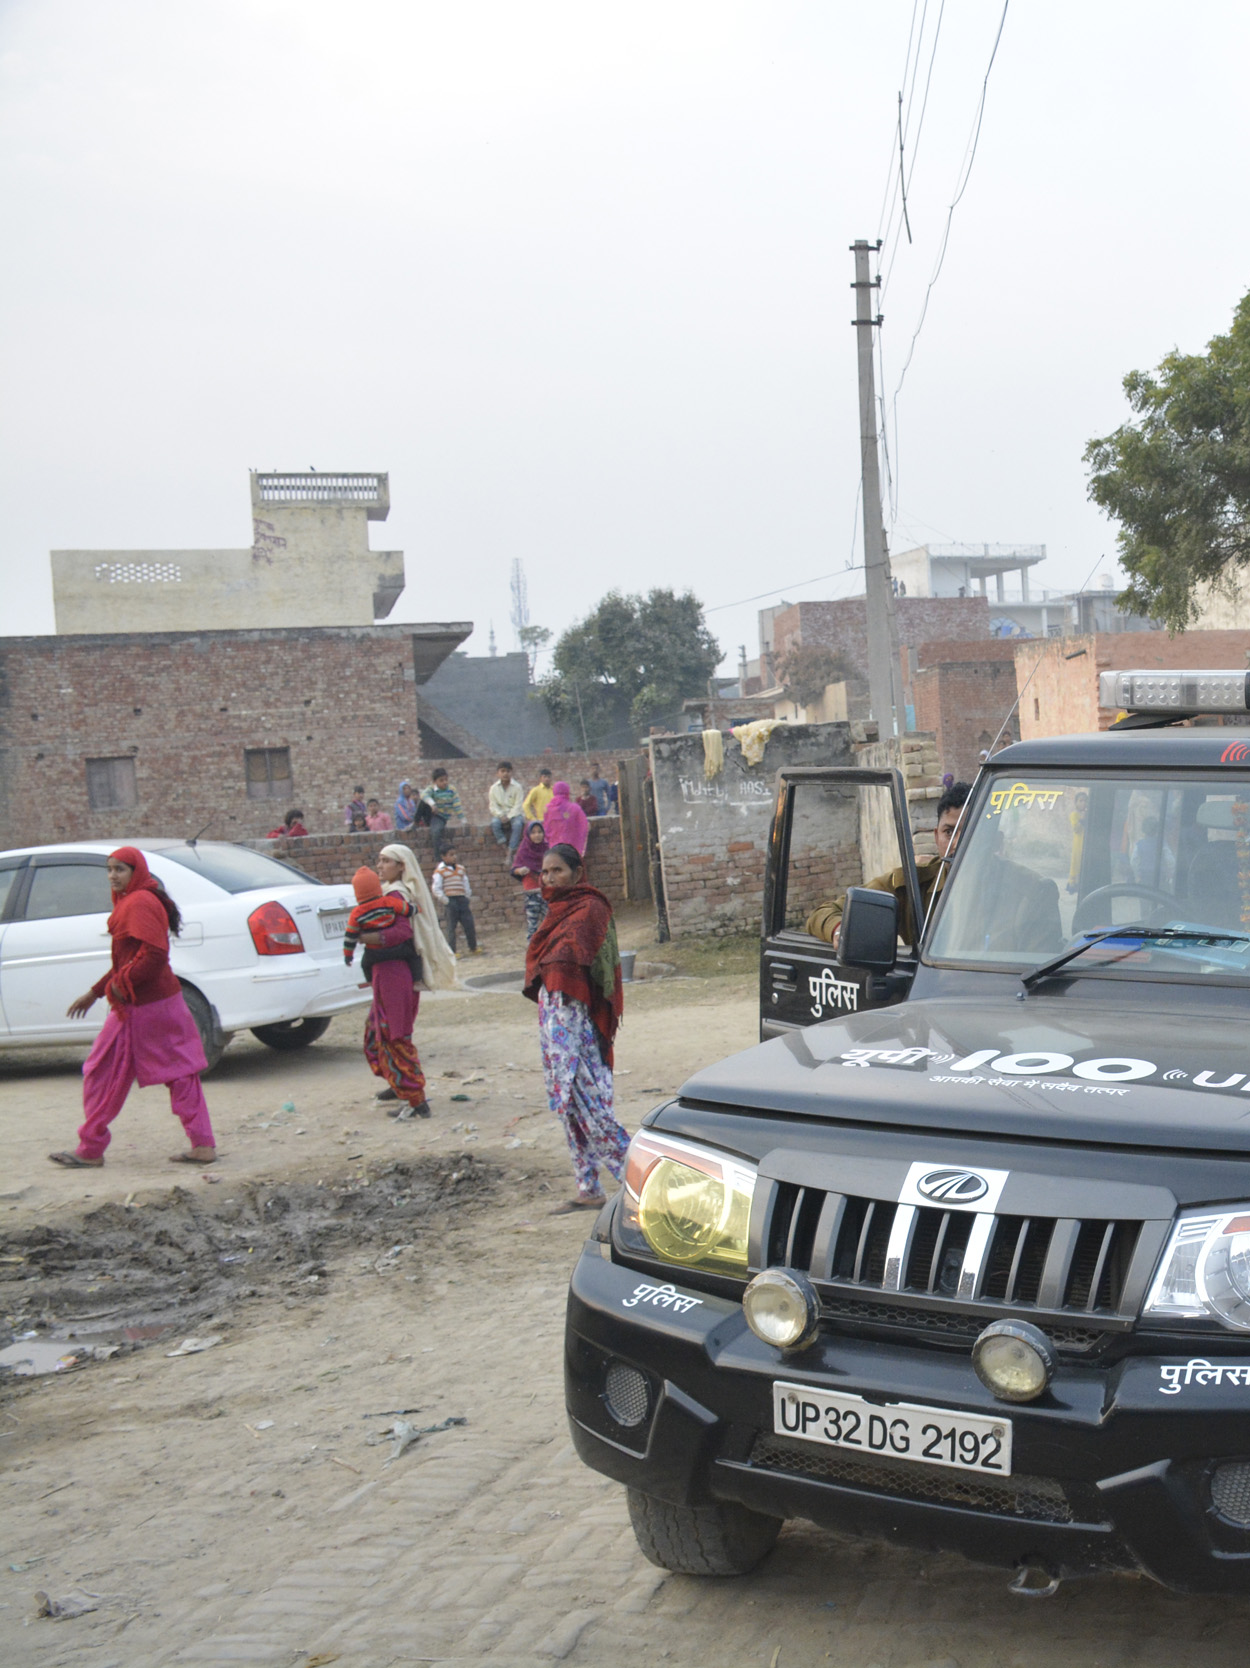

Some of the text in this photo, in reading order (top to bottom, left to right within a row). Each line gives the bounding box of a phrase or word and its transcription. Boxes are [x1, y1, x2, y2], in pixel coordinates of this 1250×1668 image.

[808, 968, 860, 1018] पुलिस
[840, 1047, 939, 1068] यूपी
[949, 1049, 1157, 1082] 100
[929, 1075, 986, 1085] आपकी
[987, 1077, 1022, 1087] सेवा
[622, 1283, 704, 1313] पुलिस
[781, 1397, 1003, 1470] UP 32 DG 2192
